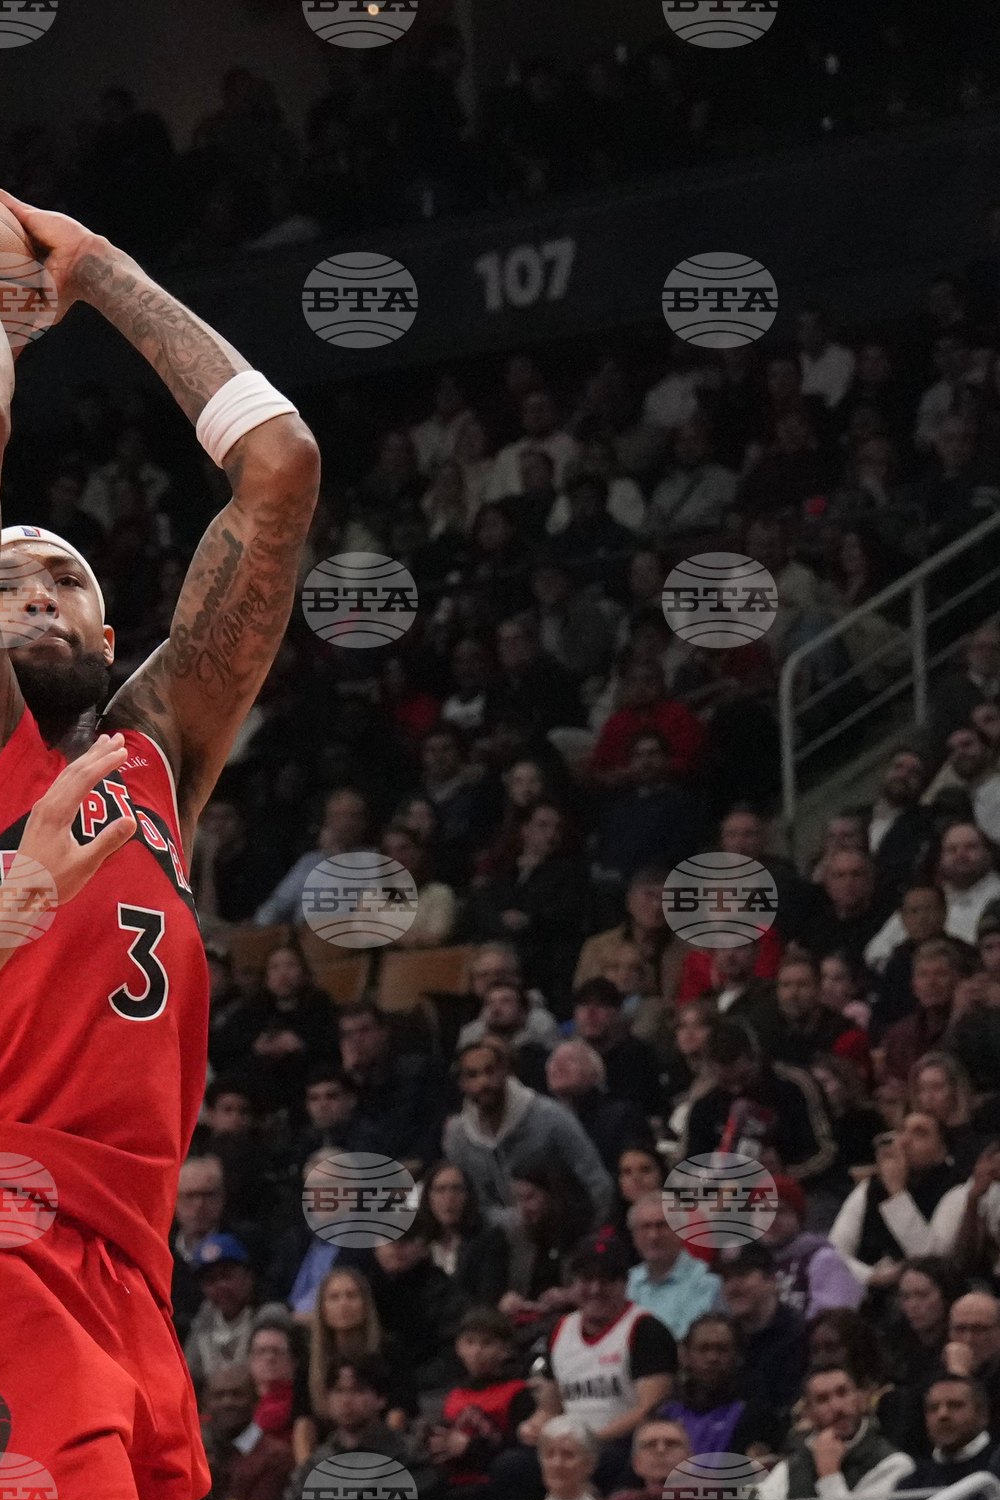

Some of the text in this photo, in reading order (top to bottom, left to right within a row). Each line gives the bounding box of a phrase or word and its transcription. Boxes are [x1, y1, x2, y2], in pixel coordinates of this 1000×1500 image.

[475, 237, 576, 311] 107
[124, 755, 149, 769] Life
[108, 902, 170, 1022] 3
